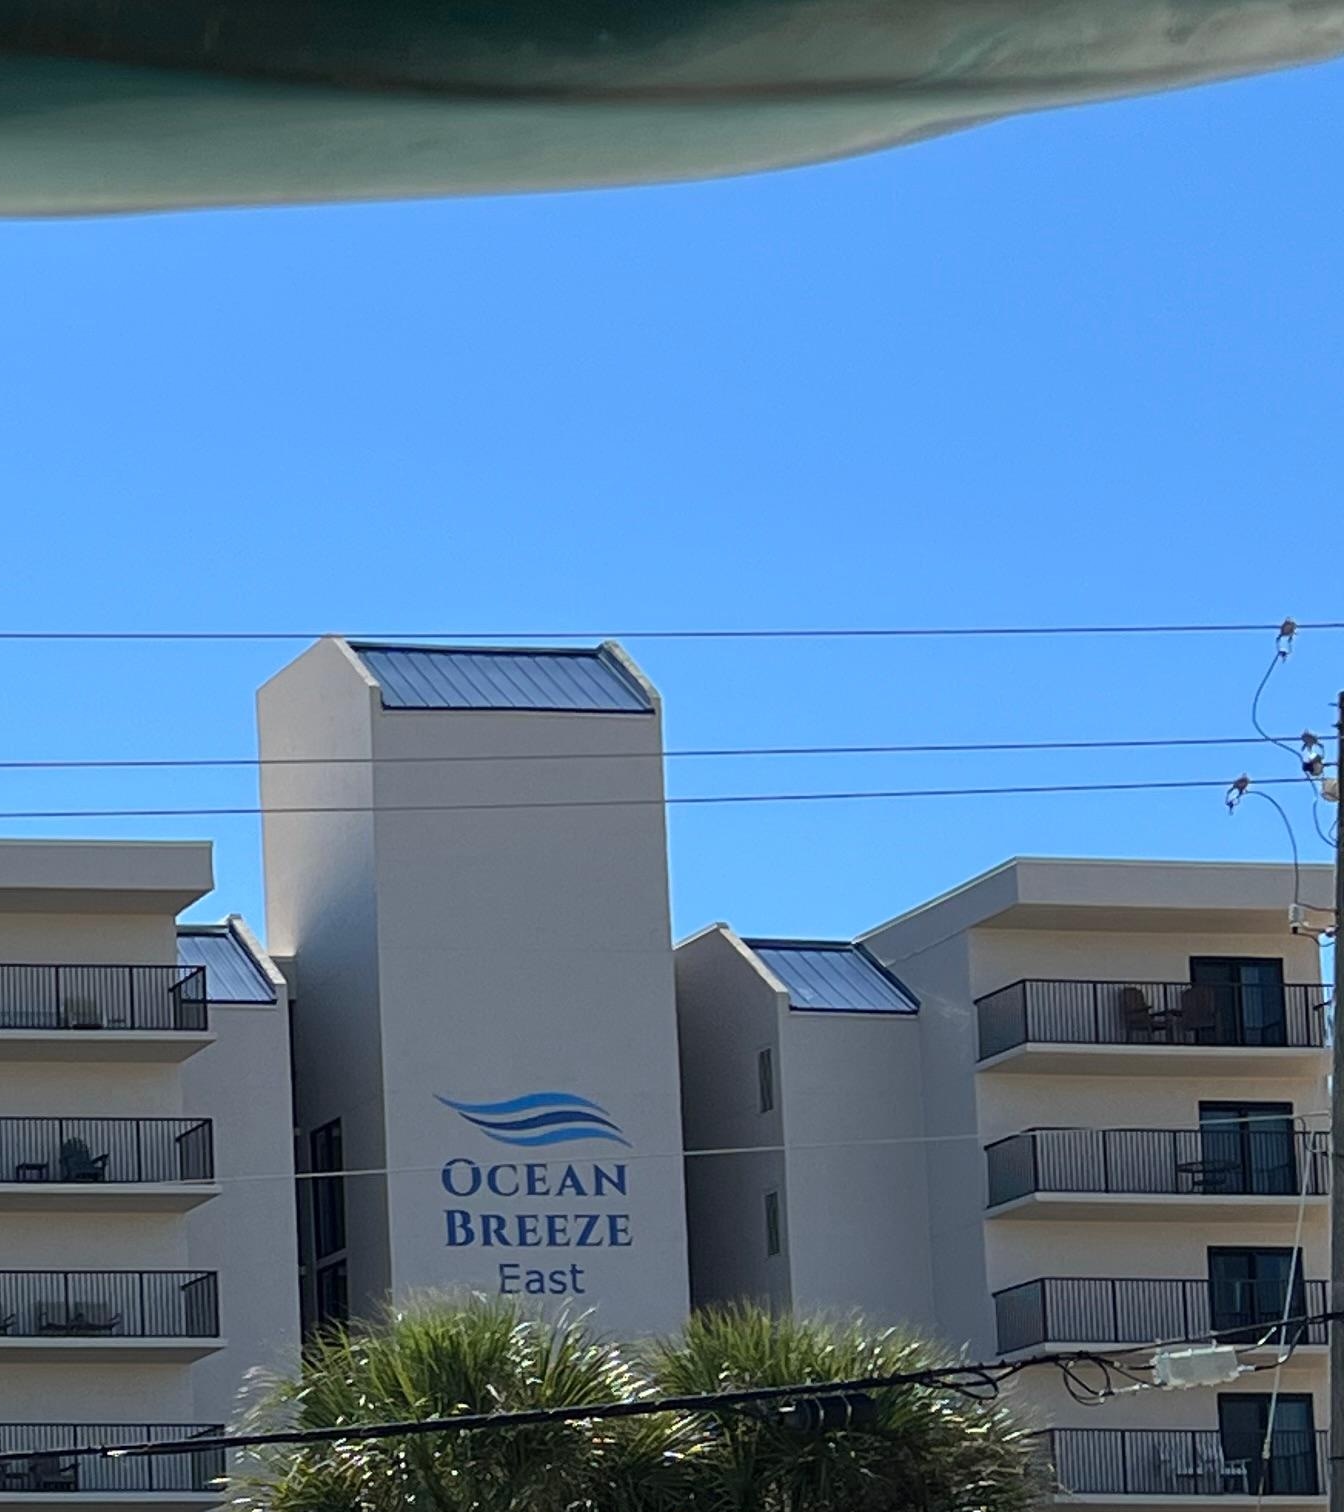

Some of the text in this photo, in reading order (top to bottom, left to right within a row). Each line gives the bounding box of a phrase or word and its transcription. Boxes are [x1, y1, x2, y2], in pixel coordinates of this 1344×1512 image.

[441, 1158, 628, 1197] OCEAN
[444, 1209, 633, 1247] BREEZE
[498, 1263, 586, 1294] East
